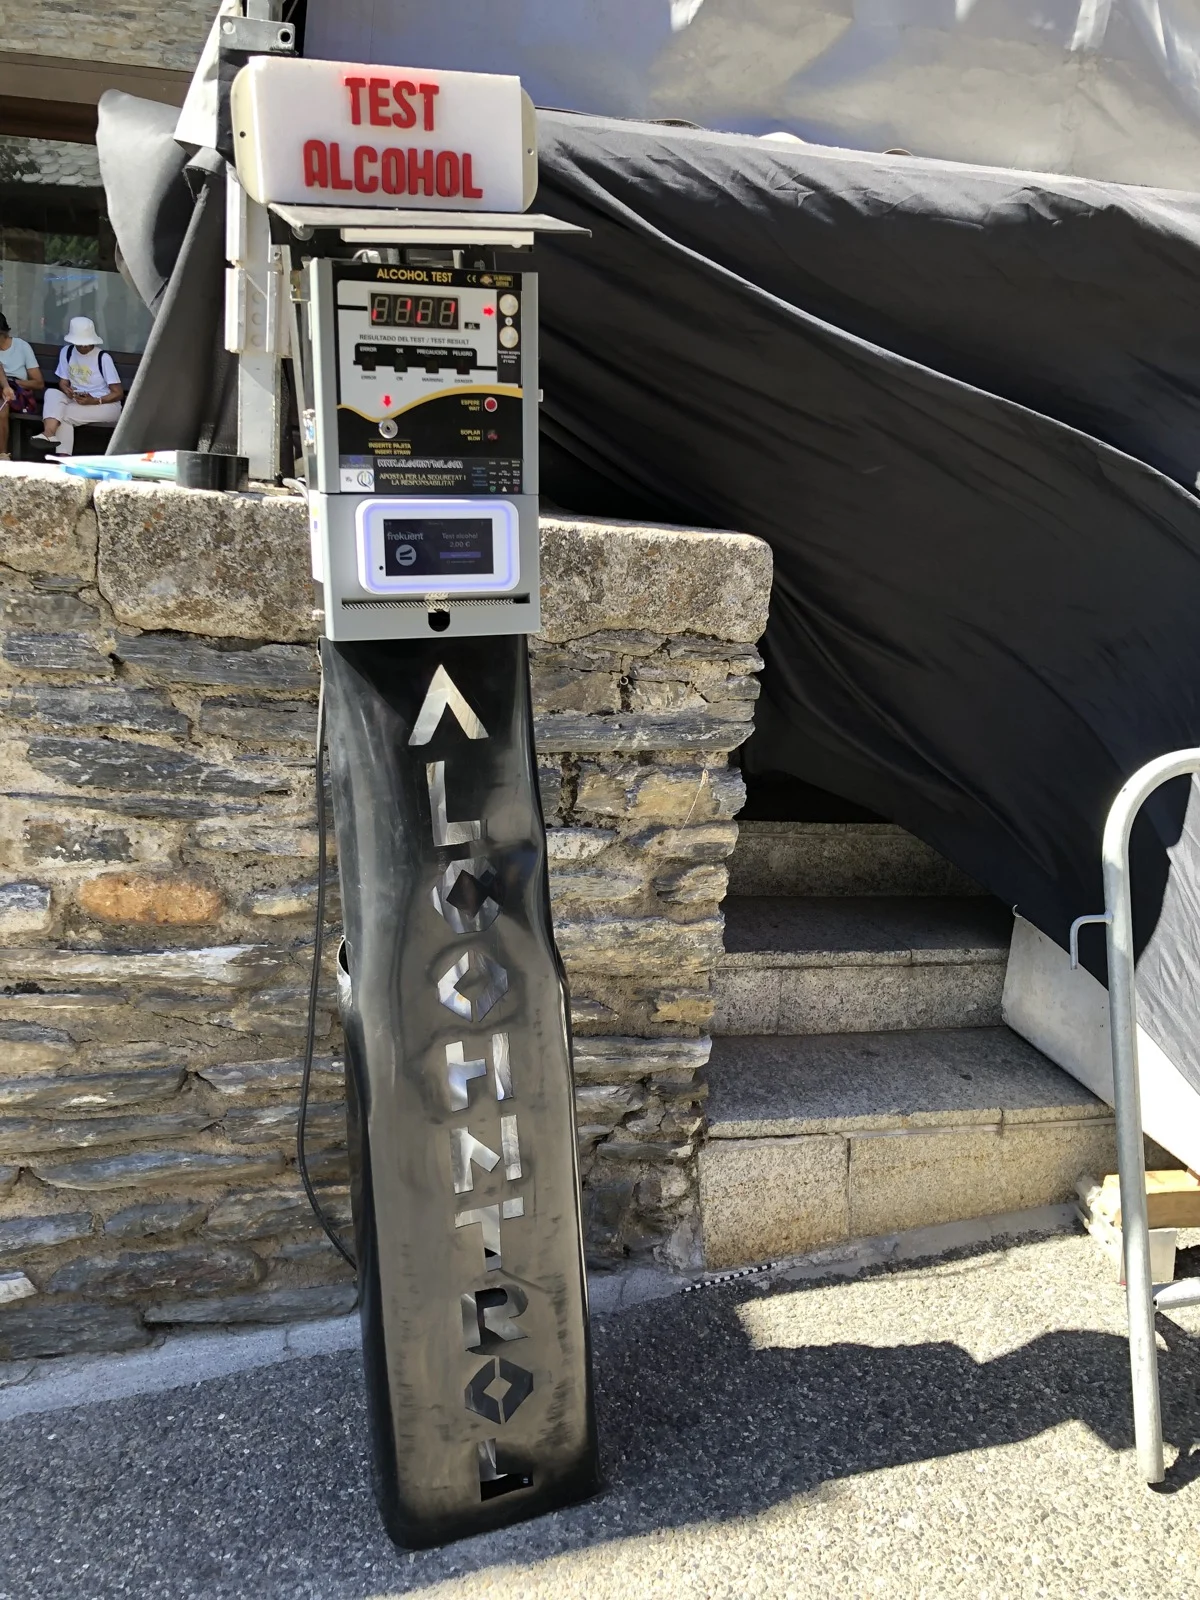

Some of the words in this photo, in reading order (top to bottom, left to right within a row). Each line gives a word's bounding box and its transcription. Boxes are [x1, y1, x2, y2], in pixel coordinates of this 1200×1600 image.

[344, 77, 440, 131] TEST
[303, 139, 483, 199] ALCOHOL
[376, 268, 429, 281] ALCOHOL
[431, 271, 453, 283] TEST
